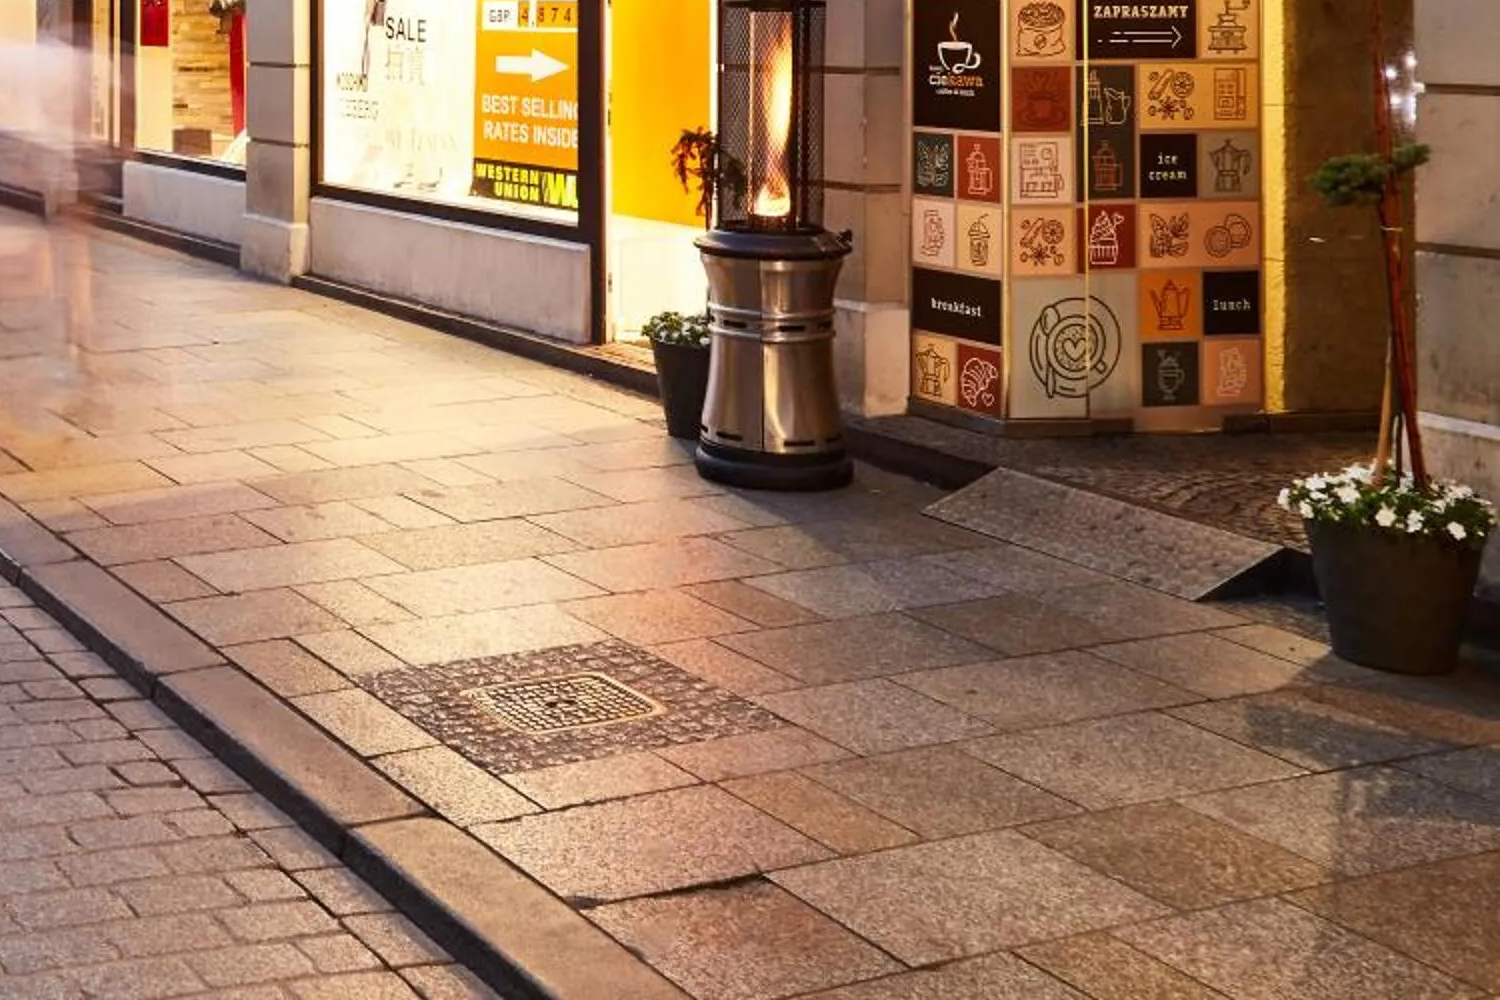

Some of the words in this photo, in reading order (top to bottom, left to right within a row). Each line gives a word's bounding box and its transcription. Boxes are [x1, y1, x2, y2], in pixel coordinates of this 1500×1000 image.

[488, 8, 511, 24] GBP
[1093, 5, 1189, 19] ZAPRASZAMY
[385, 16, 428, 43] SALE
[482, 94, 517, 115] BEST
[483, 120, 529, 143] RATES
[533, 124, 578, 149] INSIDE
[1157, 153, 1177, 166] ice
[475, 163, 540, 186] WESTERN
[1149, 169, 1188, 181] cream
[493, 182, 540, 202] UNION
[931, 297, 982, 317] breakfast
[1212, 299, 1251, 311] lunch
